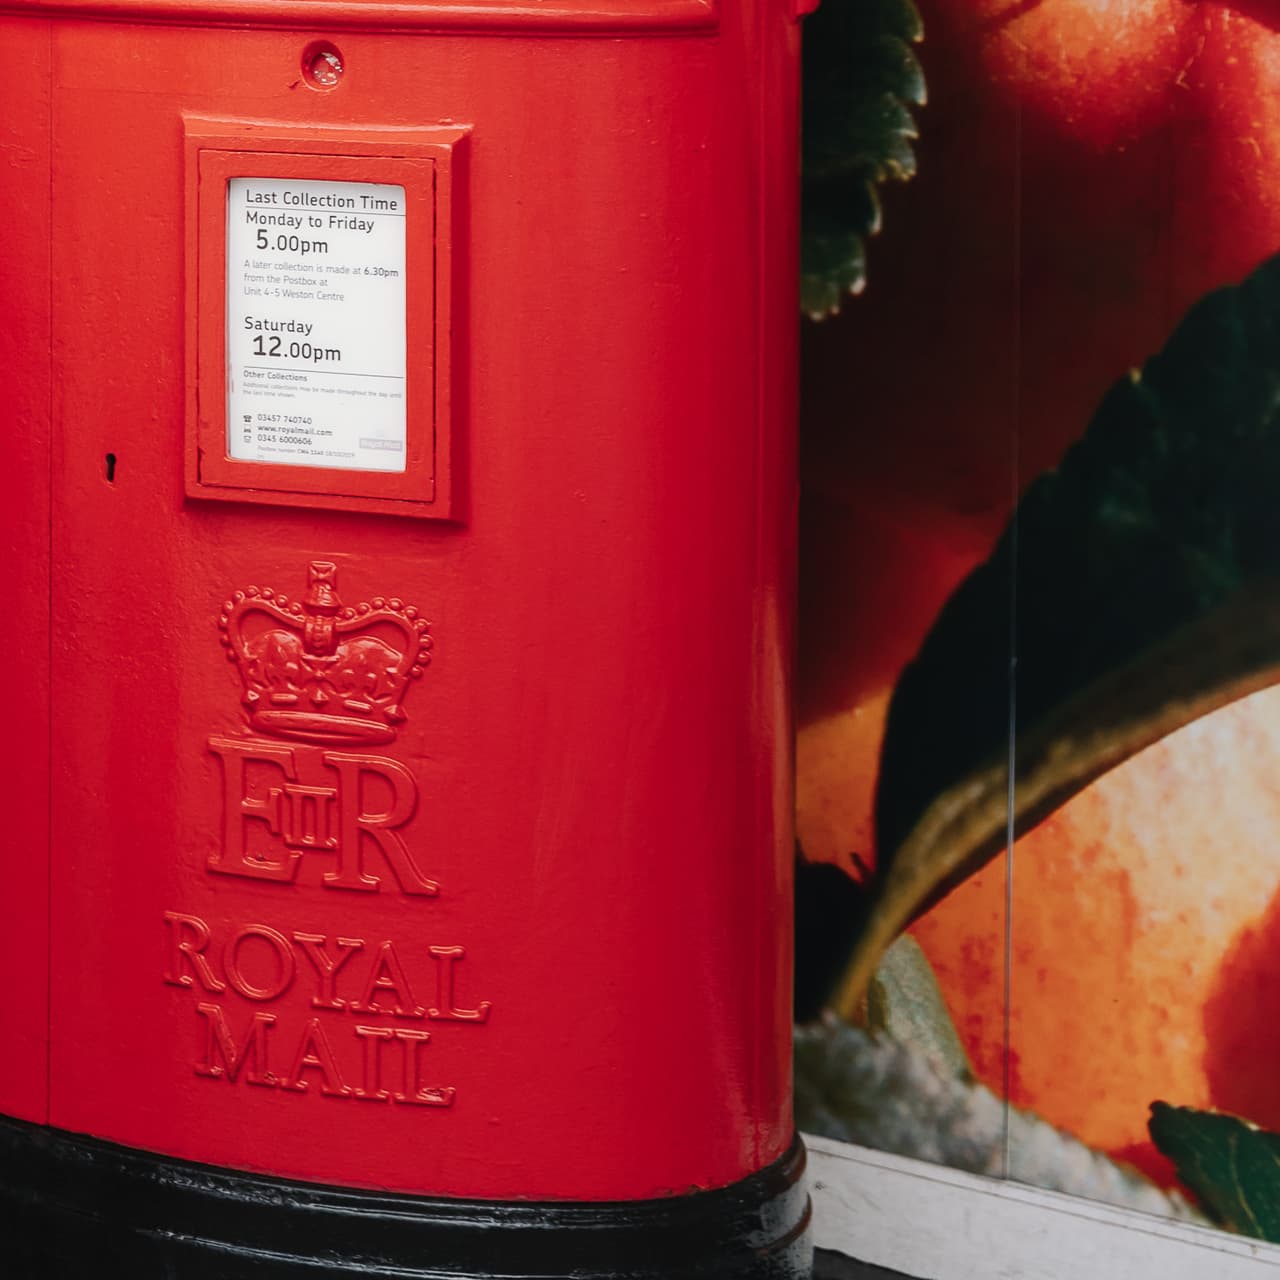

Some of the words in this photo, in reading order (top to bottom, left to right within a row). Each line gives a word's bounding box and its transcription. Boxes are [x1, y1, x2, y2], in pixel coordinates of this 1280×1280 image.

[246, 189, 277, 205] Last
[283, 191, 355, 209] Collection
[360, 195, 398, 211] Time
[246, 211, 302, 229] Monday
[308, 215, 323, 228] to
[329, 216, 374, 233] Friday
[256, 229, 328, 256] 5.00pm
[244, 260, 251, 268] A
[253, 261, 272, 270] later
[274, 263, 314, 273] collection
[316, 264, 323, 273] is
[326, 265, 350, 274] made
[352, 267, 361, 275] at
[364, 267, 399, 278] 6.30pm
[244, 274, 264, 282] from
[266, 274, 281, 283] the
[283, 275, 317, 286] Postbox
[319, 279, 328, 287] at
[244, 286, 262, 296] Unit
[282, 289, 314, 300] Weston
[316, 291, 345, 302] Centre
[244, 316, 313, 335] Saturday
[253, 335, 341, 363] 12.00pm
[243, 370, 264, 379] Other
[267, 371, 308, 382] Collections
[257, 414, 280, 423] 03457
[283, 415, 312, 425] 740740
[257, 425, 333, 437] www.royalmail.com
[257, 434, 276, 443] 0345
[164, 910, 492, 1023] ROYAL
[193, 1001, 457, 1108] MAIL
